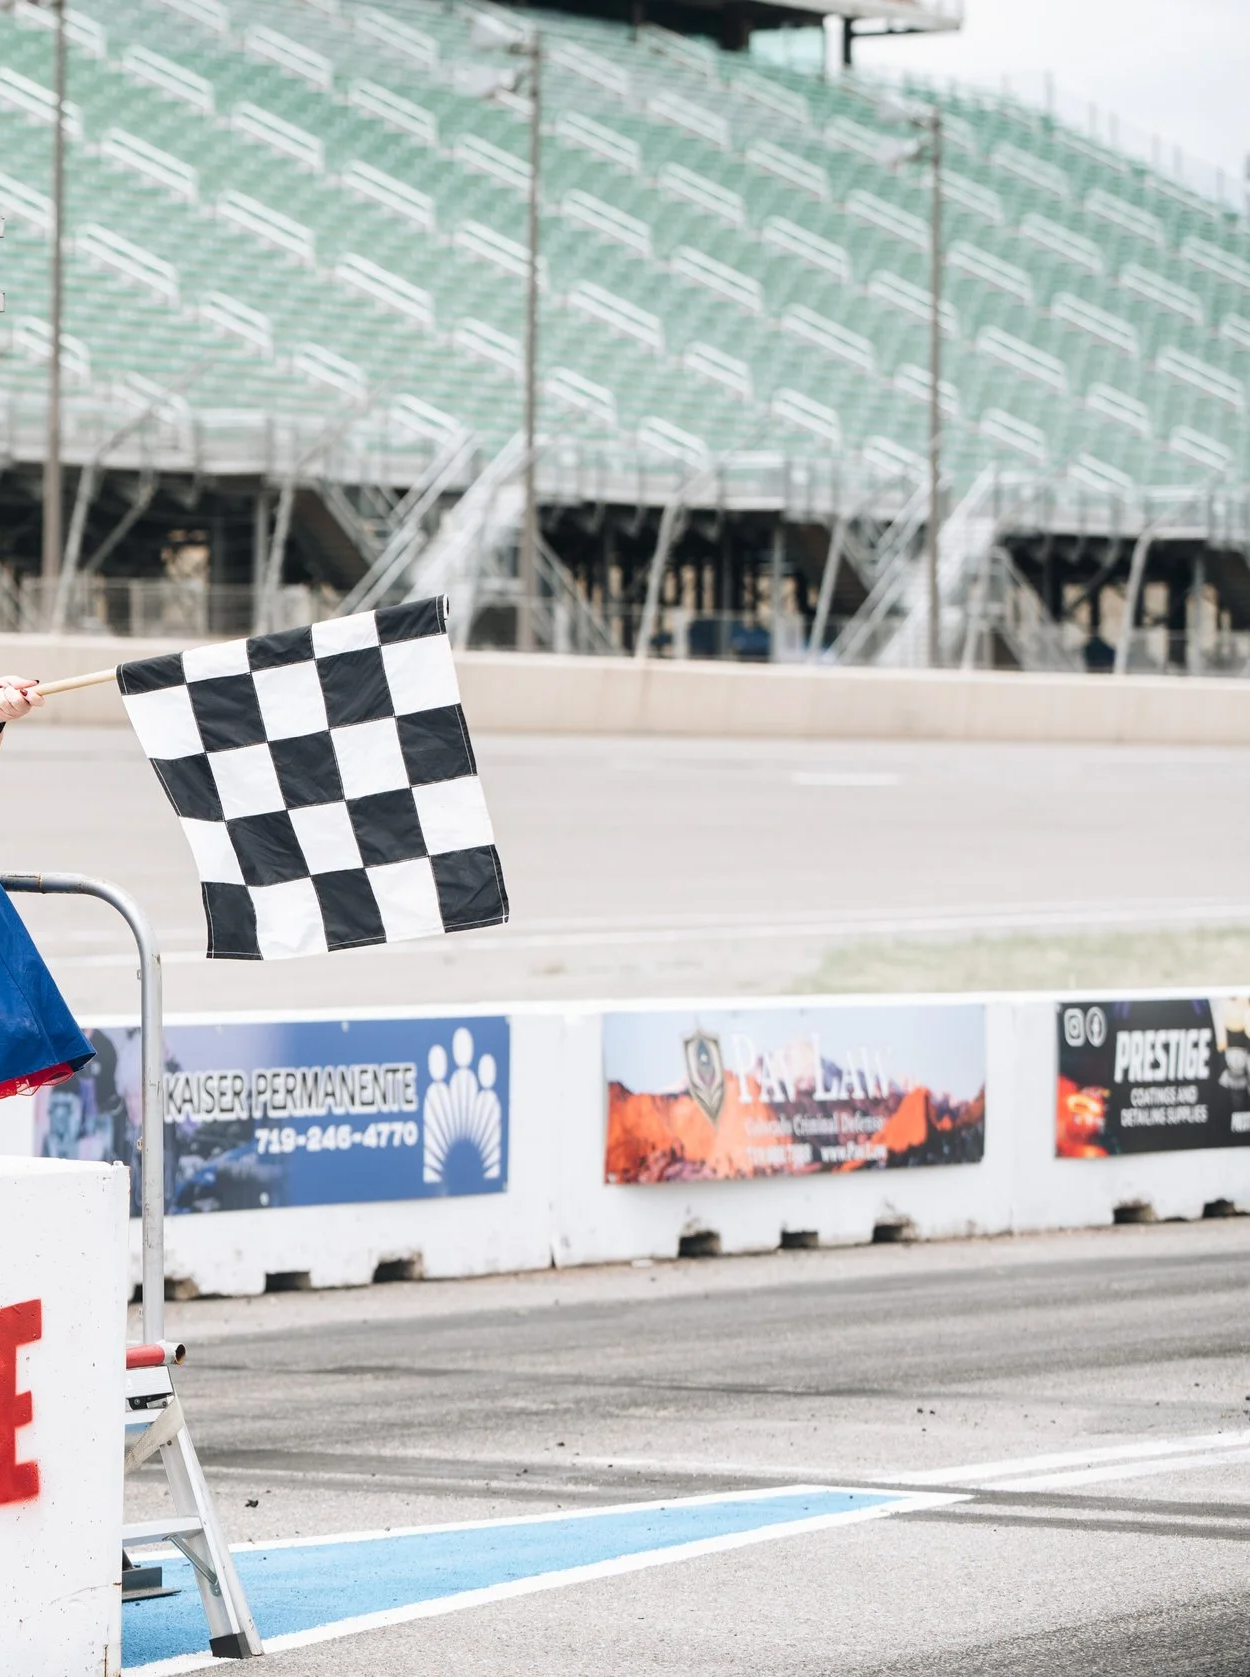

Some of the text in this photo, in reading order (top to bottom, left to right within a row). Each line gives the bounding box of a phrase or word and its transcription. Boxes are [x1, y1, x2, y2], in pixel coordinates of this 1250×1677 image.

[1114, 1029, 1212, 1082] PRESTIGE
[164, 1064, 418, 1123] KAISER PERMANENTE
